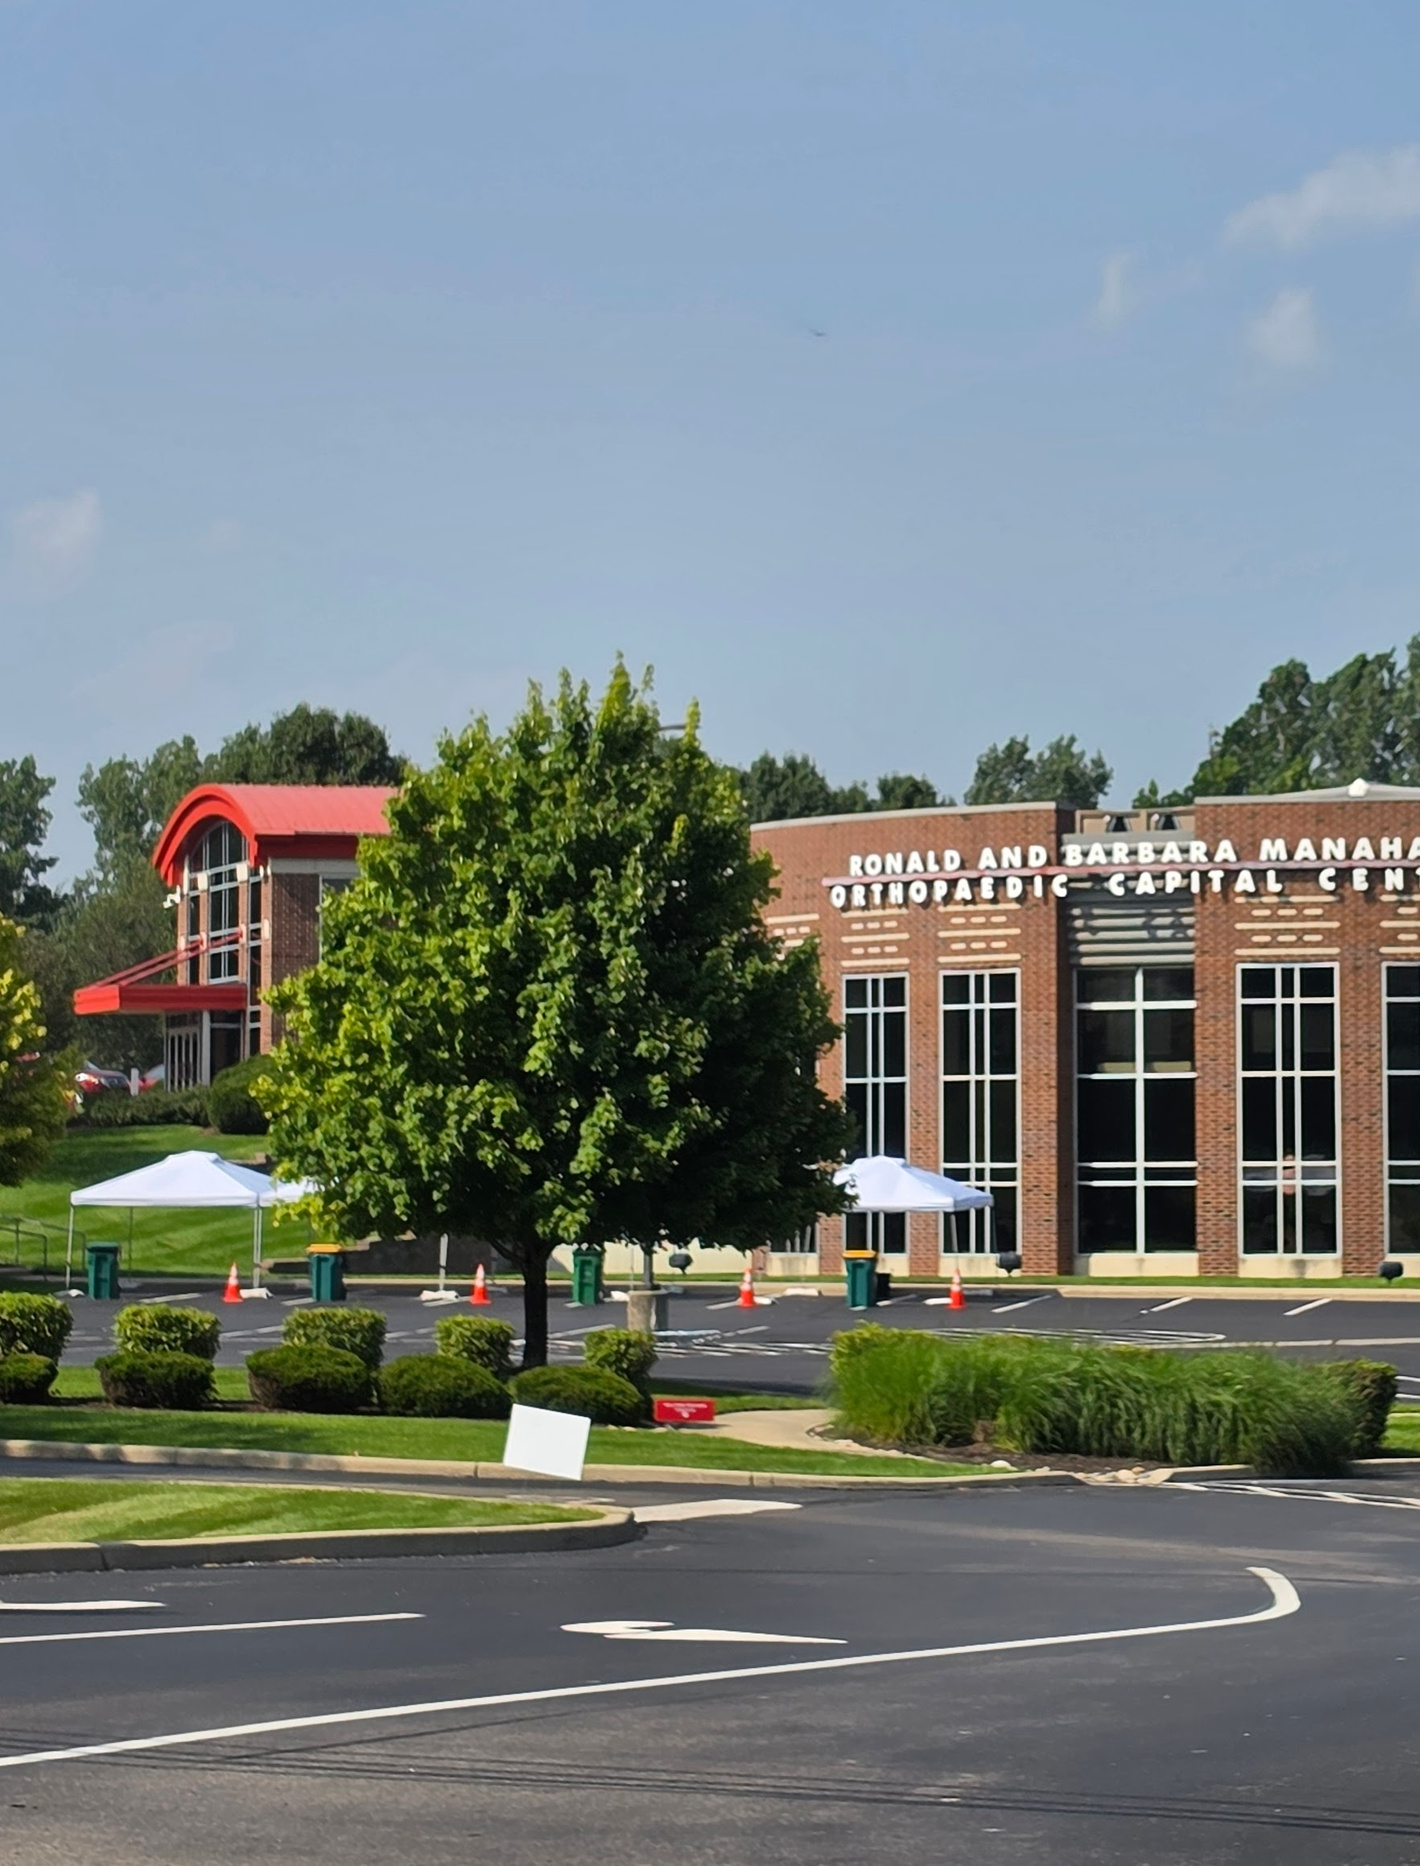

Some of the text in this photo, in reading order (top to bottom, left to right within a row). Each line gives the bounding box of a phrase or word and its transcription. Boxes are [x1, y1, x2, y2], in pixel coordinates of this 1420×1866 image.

[850, 849, 961, 877] RONALD
[978, 845, 1048, 870] AND
[1065, 839, 1237, 866] BARBARA
[831, 873, 1068, 908] ORTHOPAEDIC
[1108, 869, 1283, 896] CAPITAL
